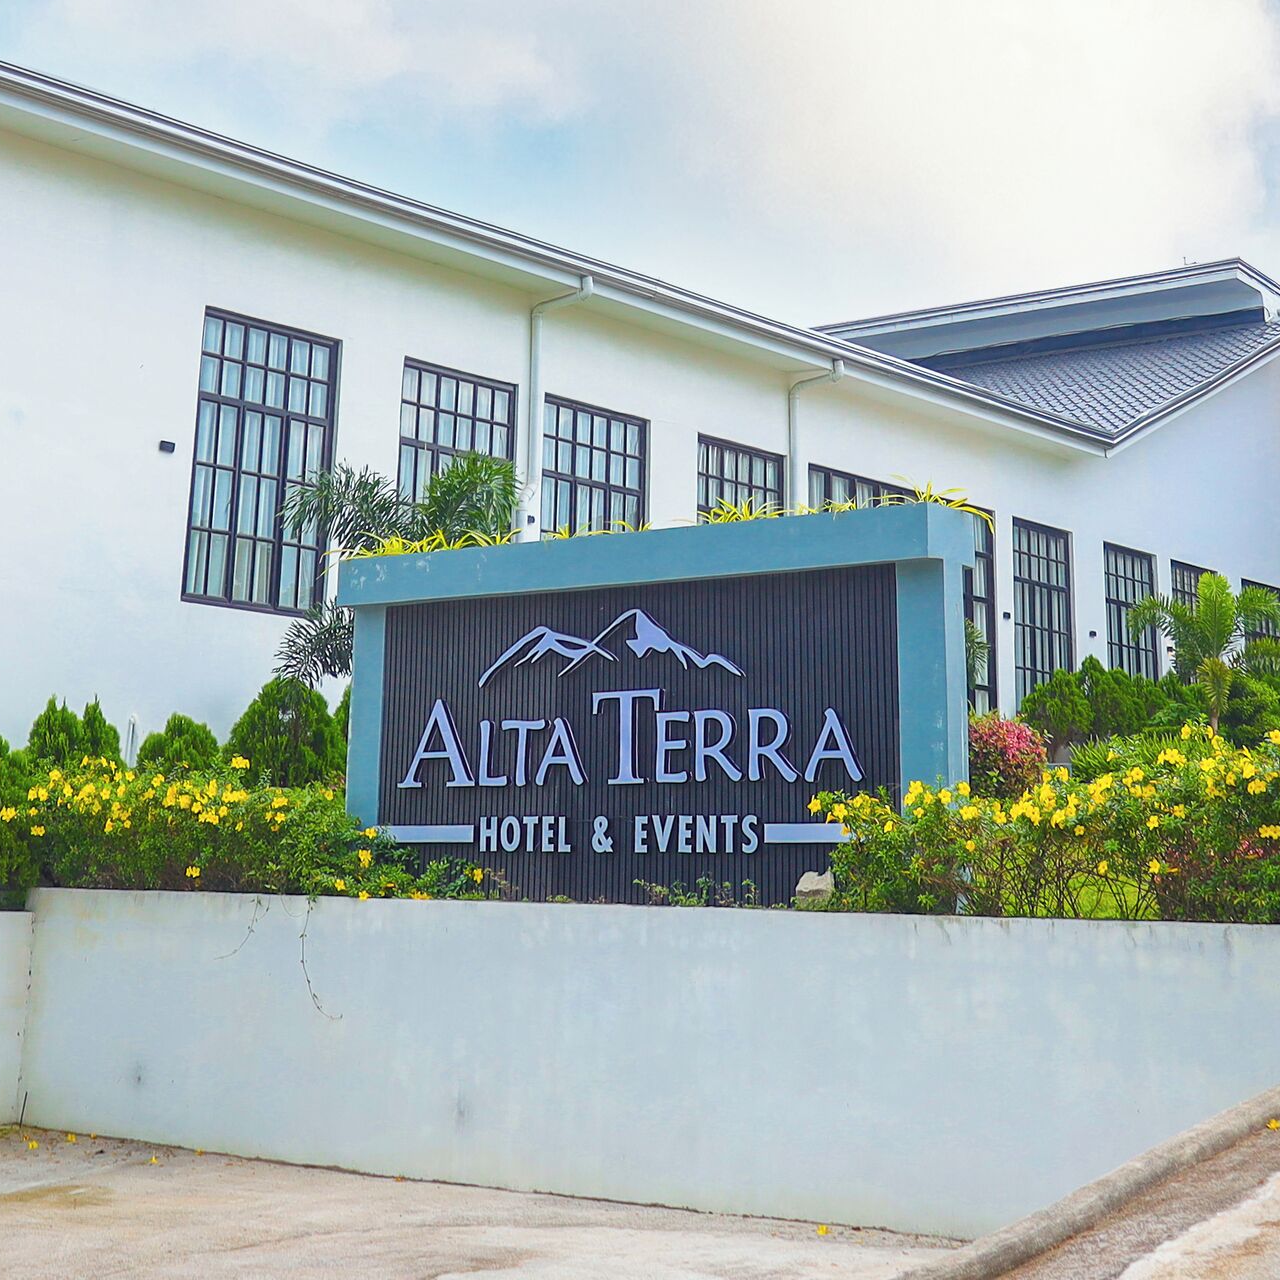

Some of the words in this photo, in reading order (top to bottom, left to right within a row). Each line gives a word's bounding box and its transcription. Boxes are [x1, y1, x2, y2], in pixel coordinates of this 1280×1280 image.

[396, 698, 586, 788] ALTA
[591, 688, 864, 785] TERRA
[479, 816, 572, 853] HOTEL
[590, 815, 614, 853] &
[634, 814, 759, 853] EVENTS
